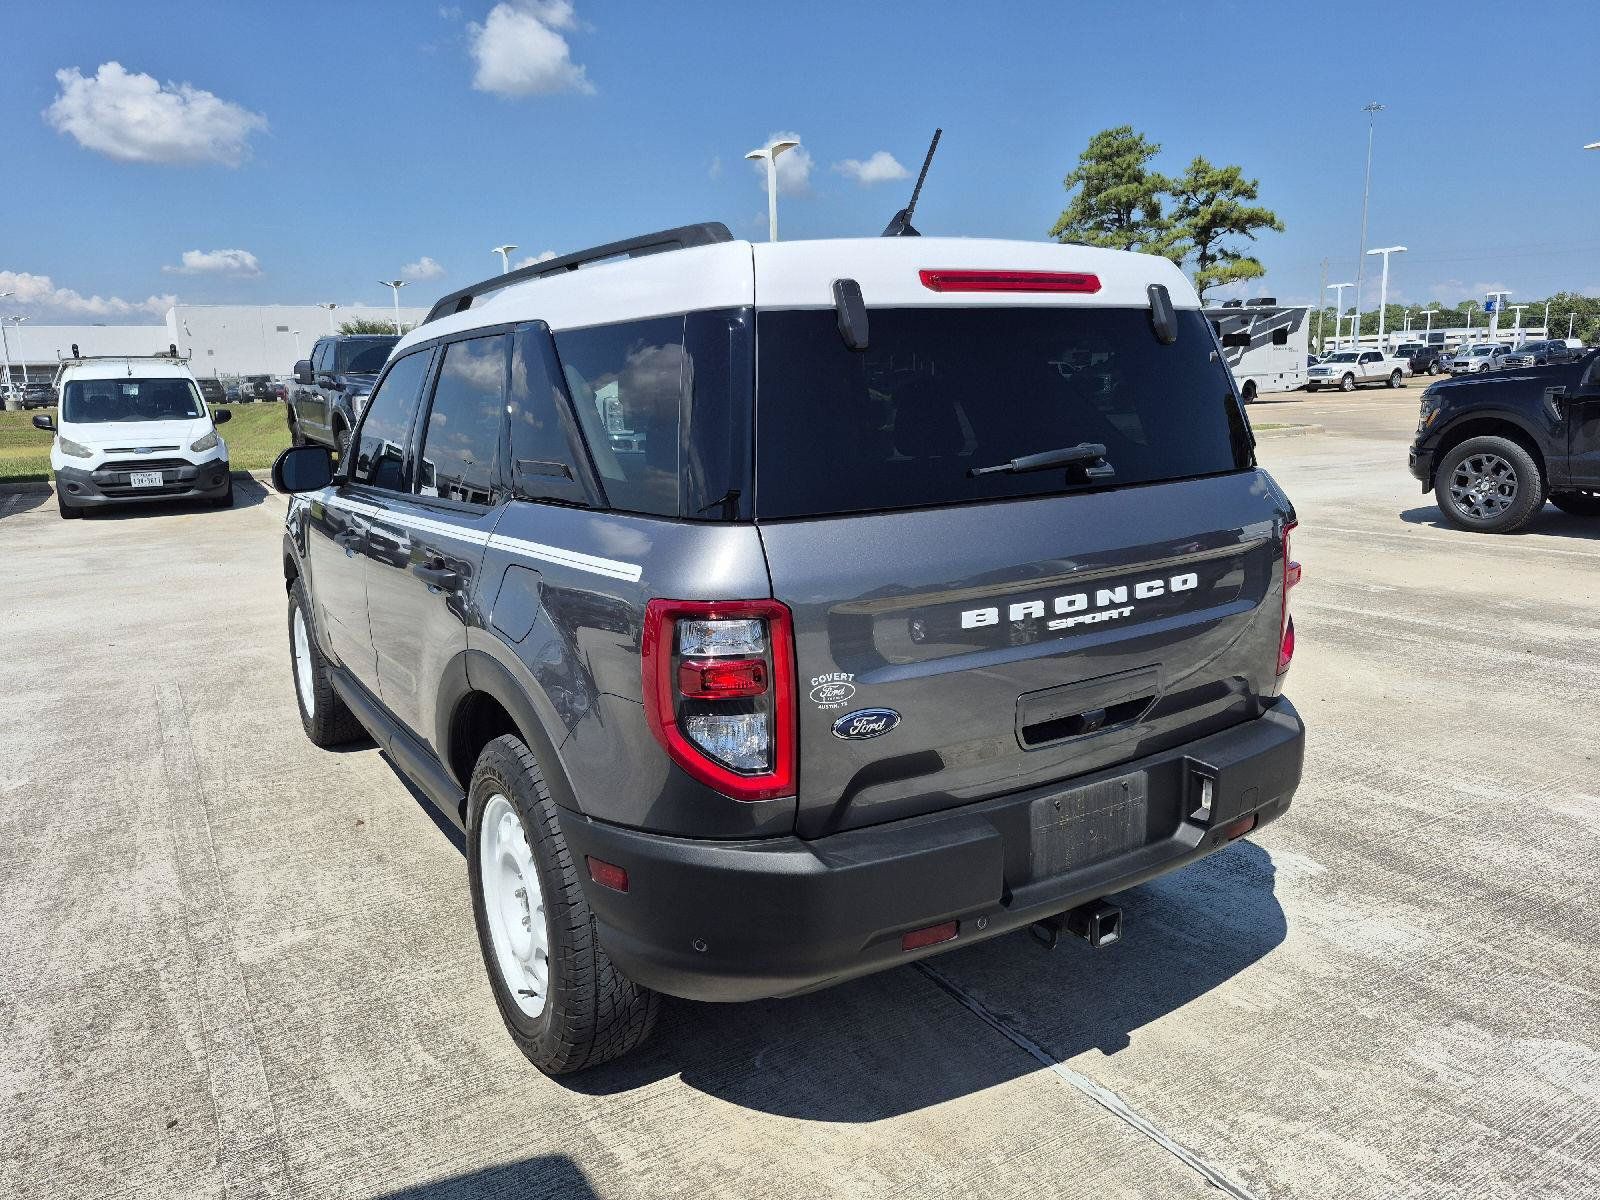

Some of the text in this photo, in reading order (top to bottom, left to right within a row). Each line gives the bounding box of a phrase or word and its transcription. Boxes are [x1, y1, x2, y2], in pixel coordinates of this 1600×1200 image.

[961, 573, 1198, 629] BRONCO
[1048, 606, 1135, 631] SPORT
[811, 672, 855, 686] COVERT
[820, 685, 846, 698] Ford
[849, 715, 887, 735] Ford
